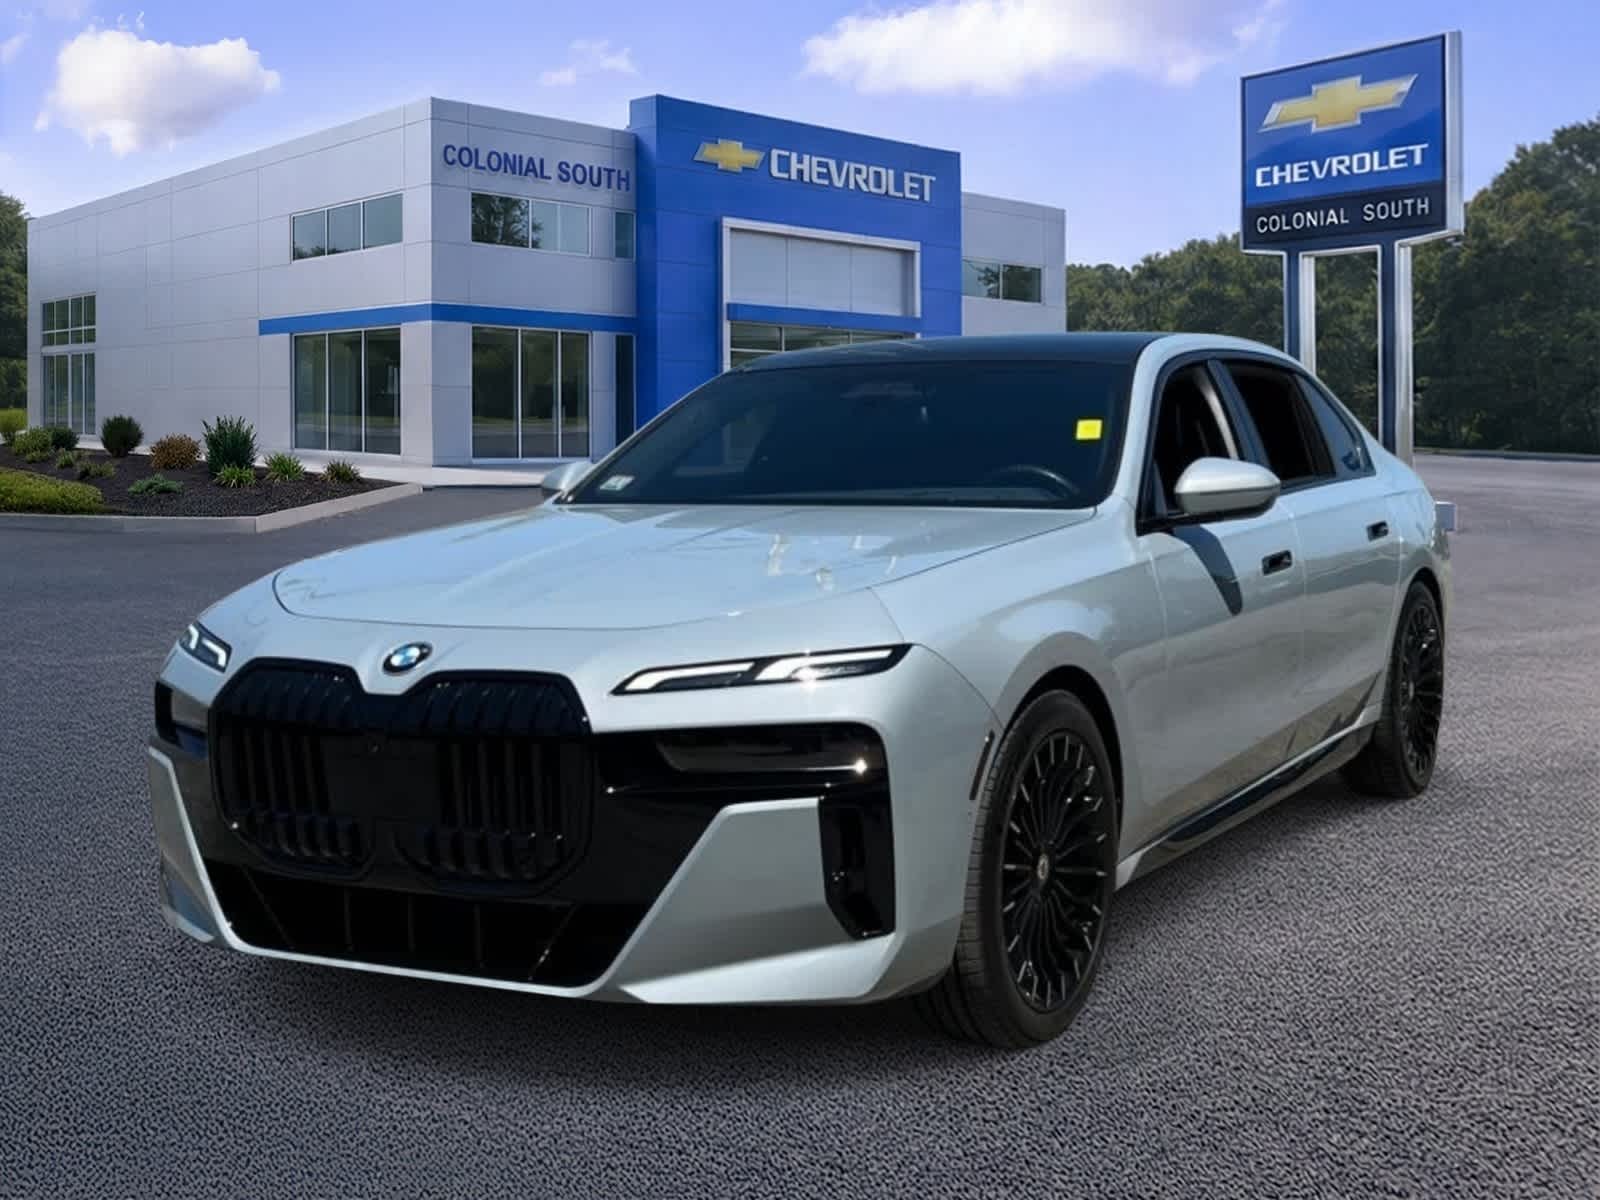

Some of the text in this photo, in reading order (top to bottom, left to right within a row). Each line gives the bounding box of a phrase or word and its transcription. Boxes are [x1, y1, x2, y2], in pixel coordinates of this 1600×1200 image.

[442, 144, 630, 192] COLONIAL SOUTH
[768, 147, 936, 202] CHEVROLET
[1255, 143, 1429, 187] CHEVROLET
[1256, 197, 1430, 233] COLONIAL SOUTH
